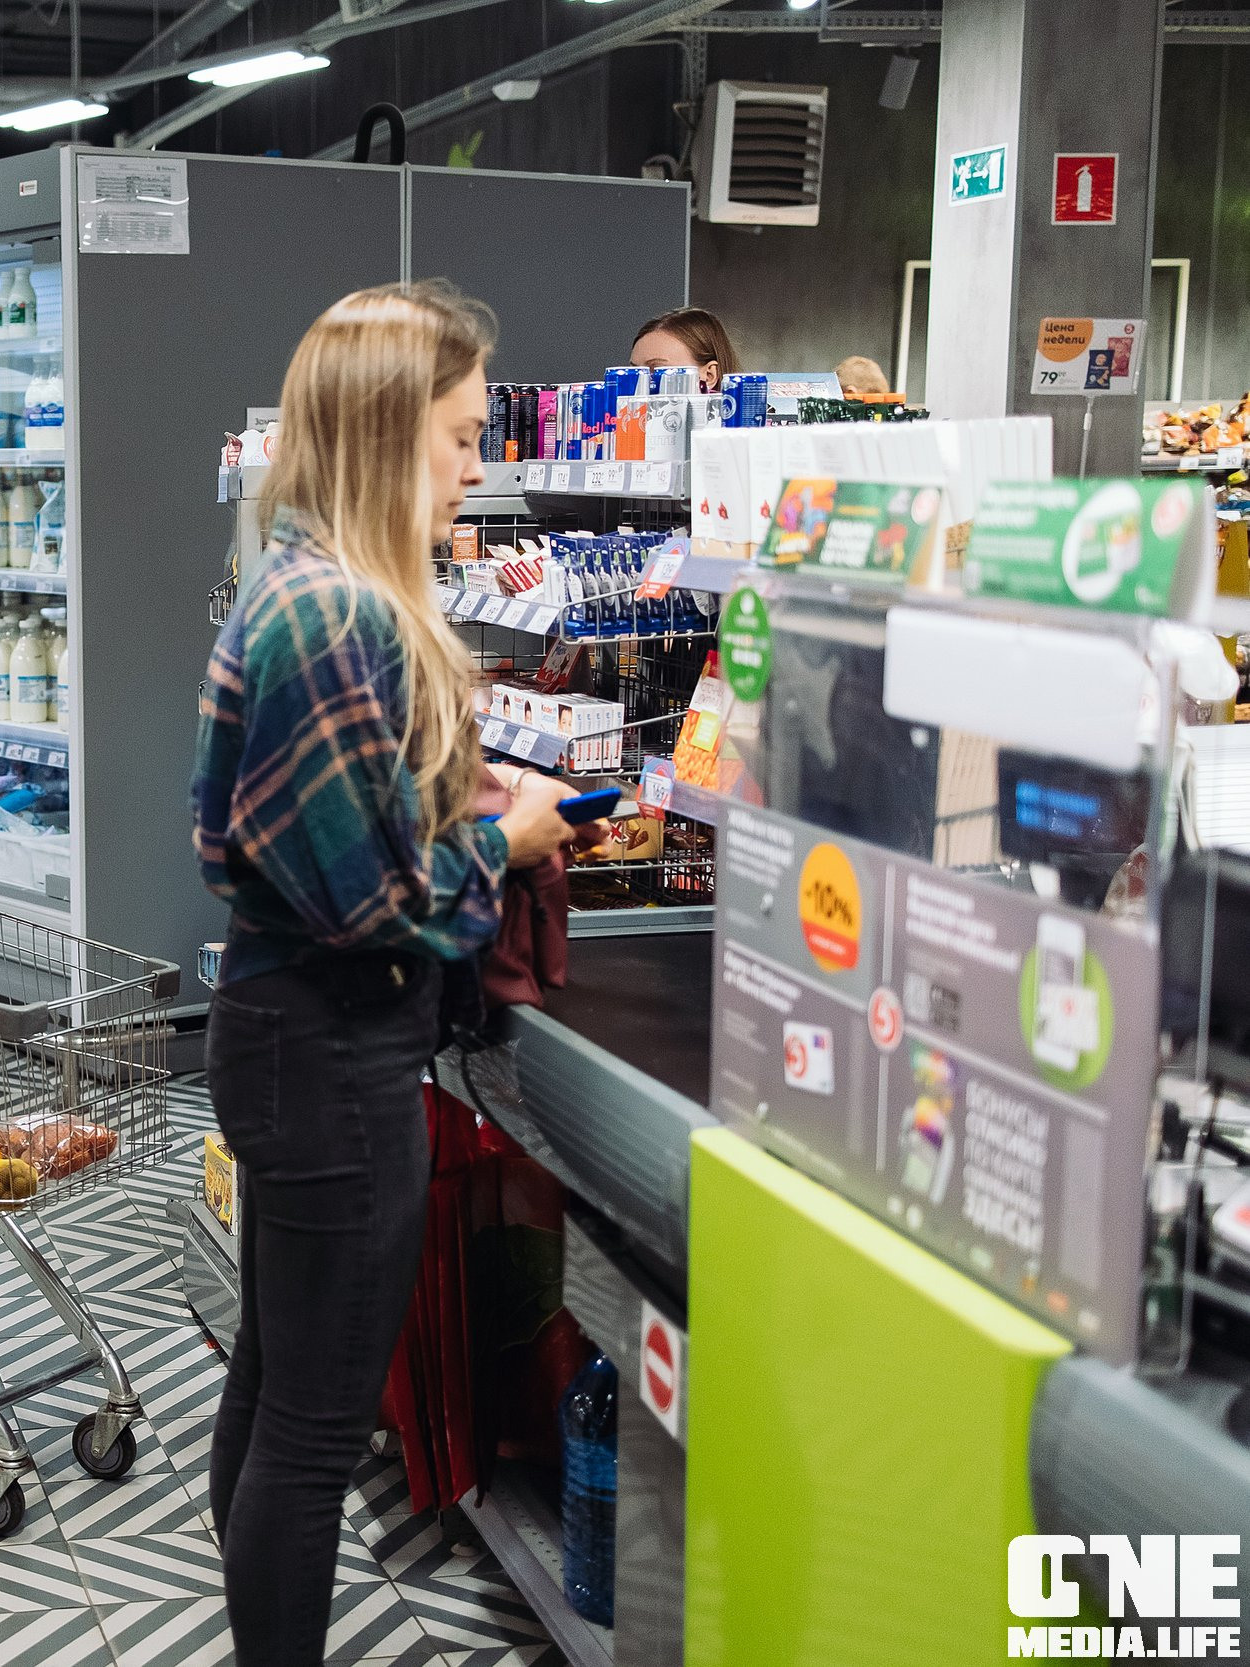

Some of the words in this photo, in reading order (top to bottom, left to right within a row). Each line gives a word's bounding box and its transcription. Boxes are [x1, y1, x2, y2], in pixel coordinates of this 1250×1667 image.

[1045, 323, 1075, 334] Цена
[1043, 335, 1086, 345] недели
[1040, 371, 1058, 384] 79
[582, 422, 600, 433] Red
